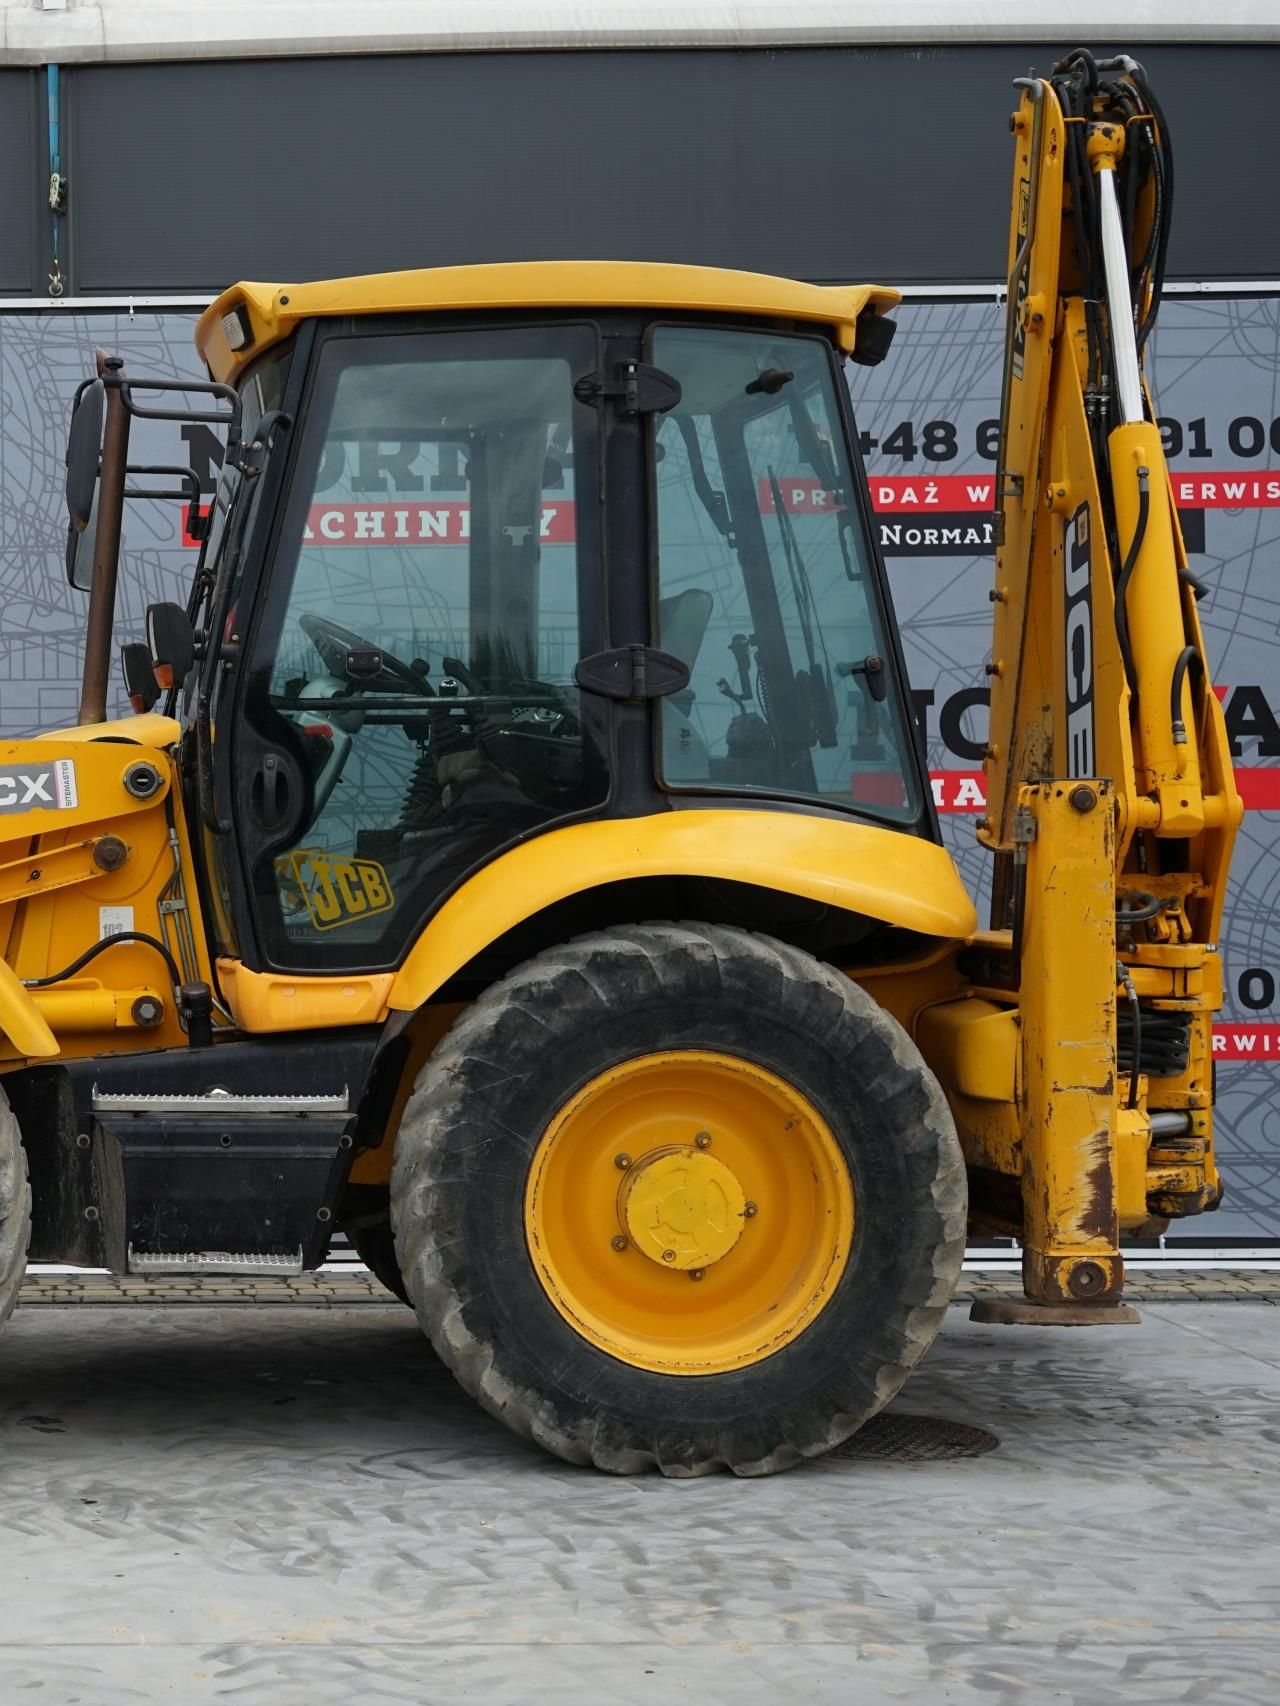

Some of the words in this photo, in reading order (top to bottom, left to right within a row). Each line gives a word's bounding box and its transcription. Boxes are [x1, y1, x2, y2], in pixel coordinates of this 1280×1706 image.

[1156, 415, 1213, 459] 91
[61, 761, 73, 807] SITEMASTER
[310, 860, 388, 922] JCB
